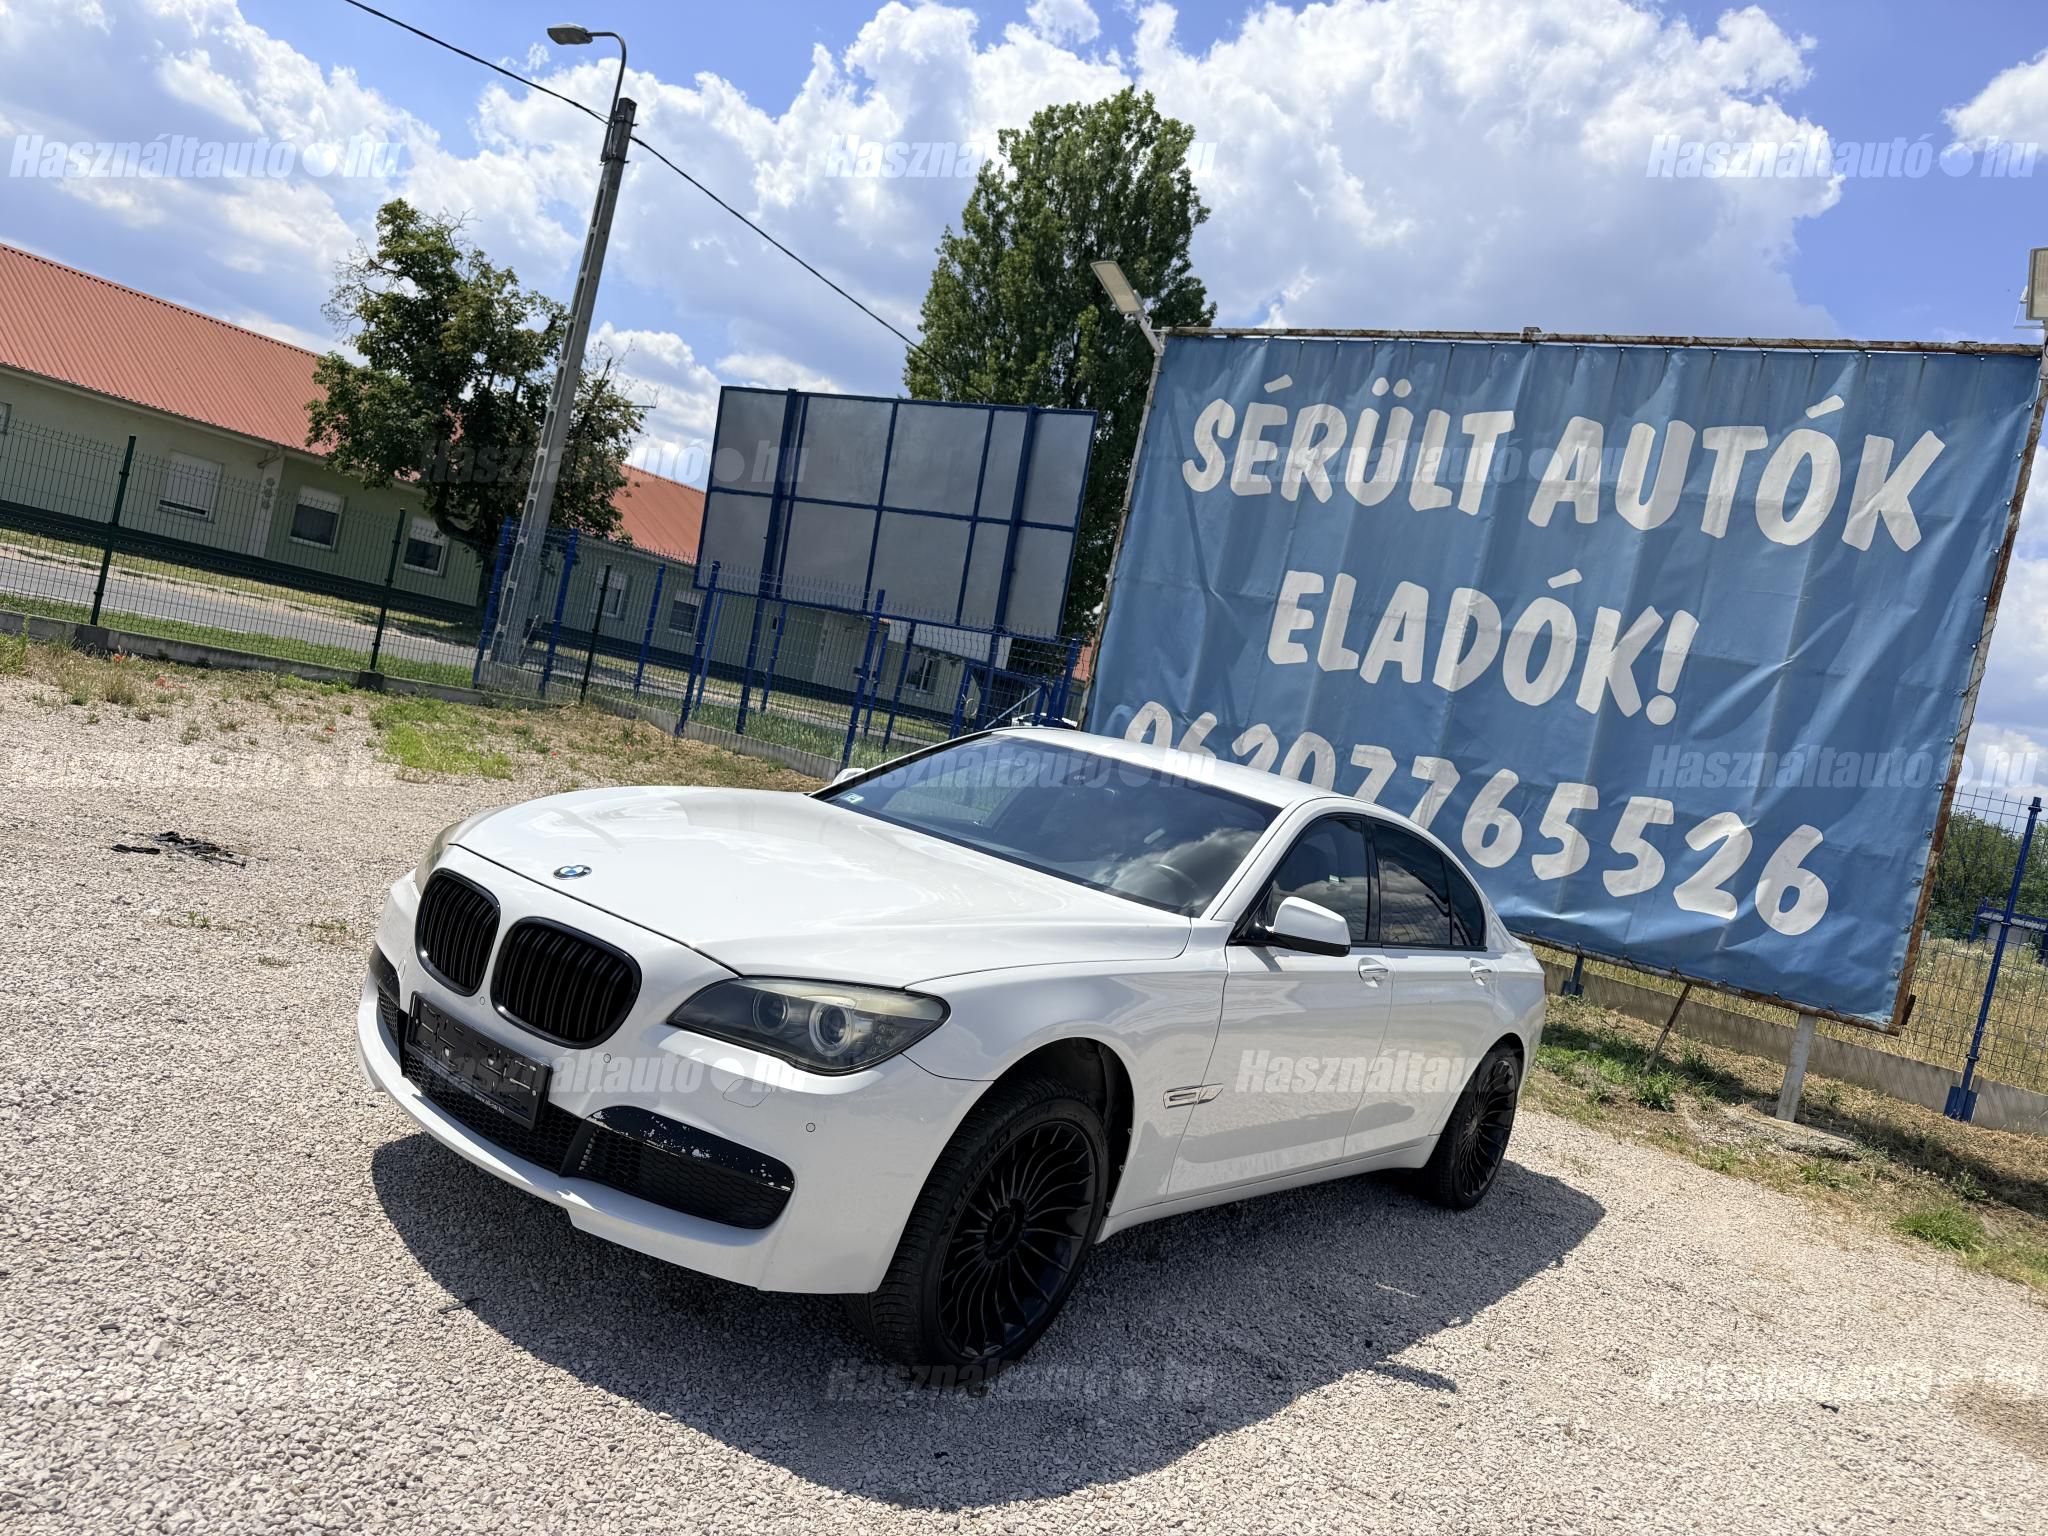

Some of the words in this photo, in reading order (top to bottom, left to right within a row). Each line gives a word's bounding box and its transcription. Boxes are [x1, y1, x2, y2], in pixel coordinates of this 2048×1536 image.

[1182, 375, 1515, 516] SÉRÜLT
[1528, 395, 1945, 551] AUTÓK
[1268, 569, 1699, 726] ELADÓK!
